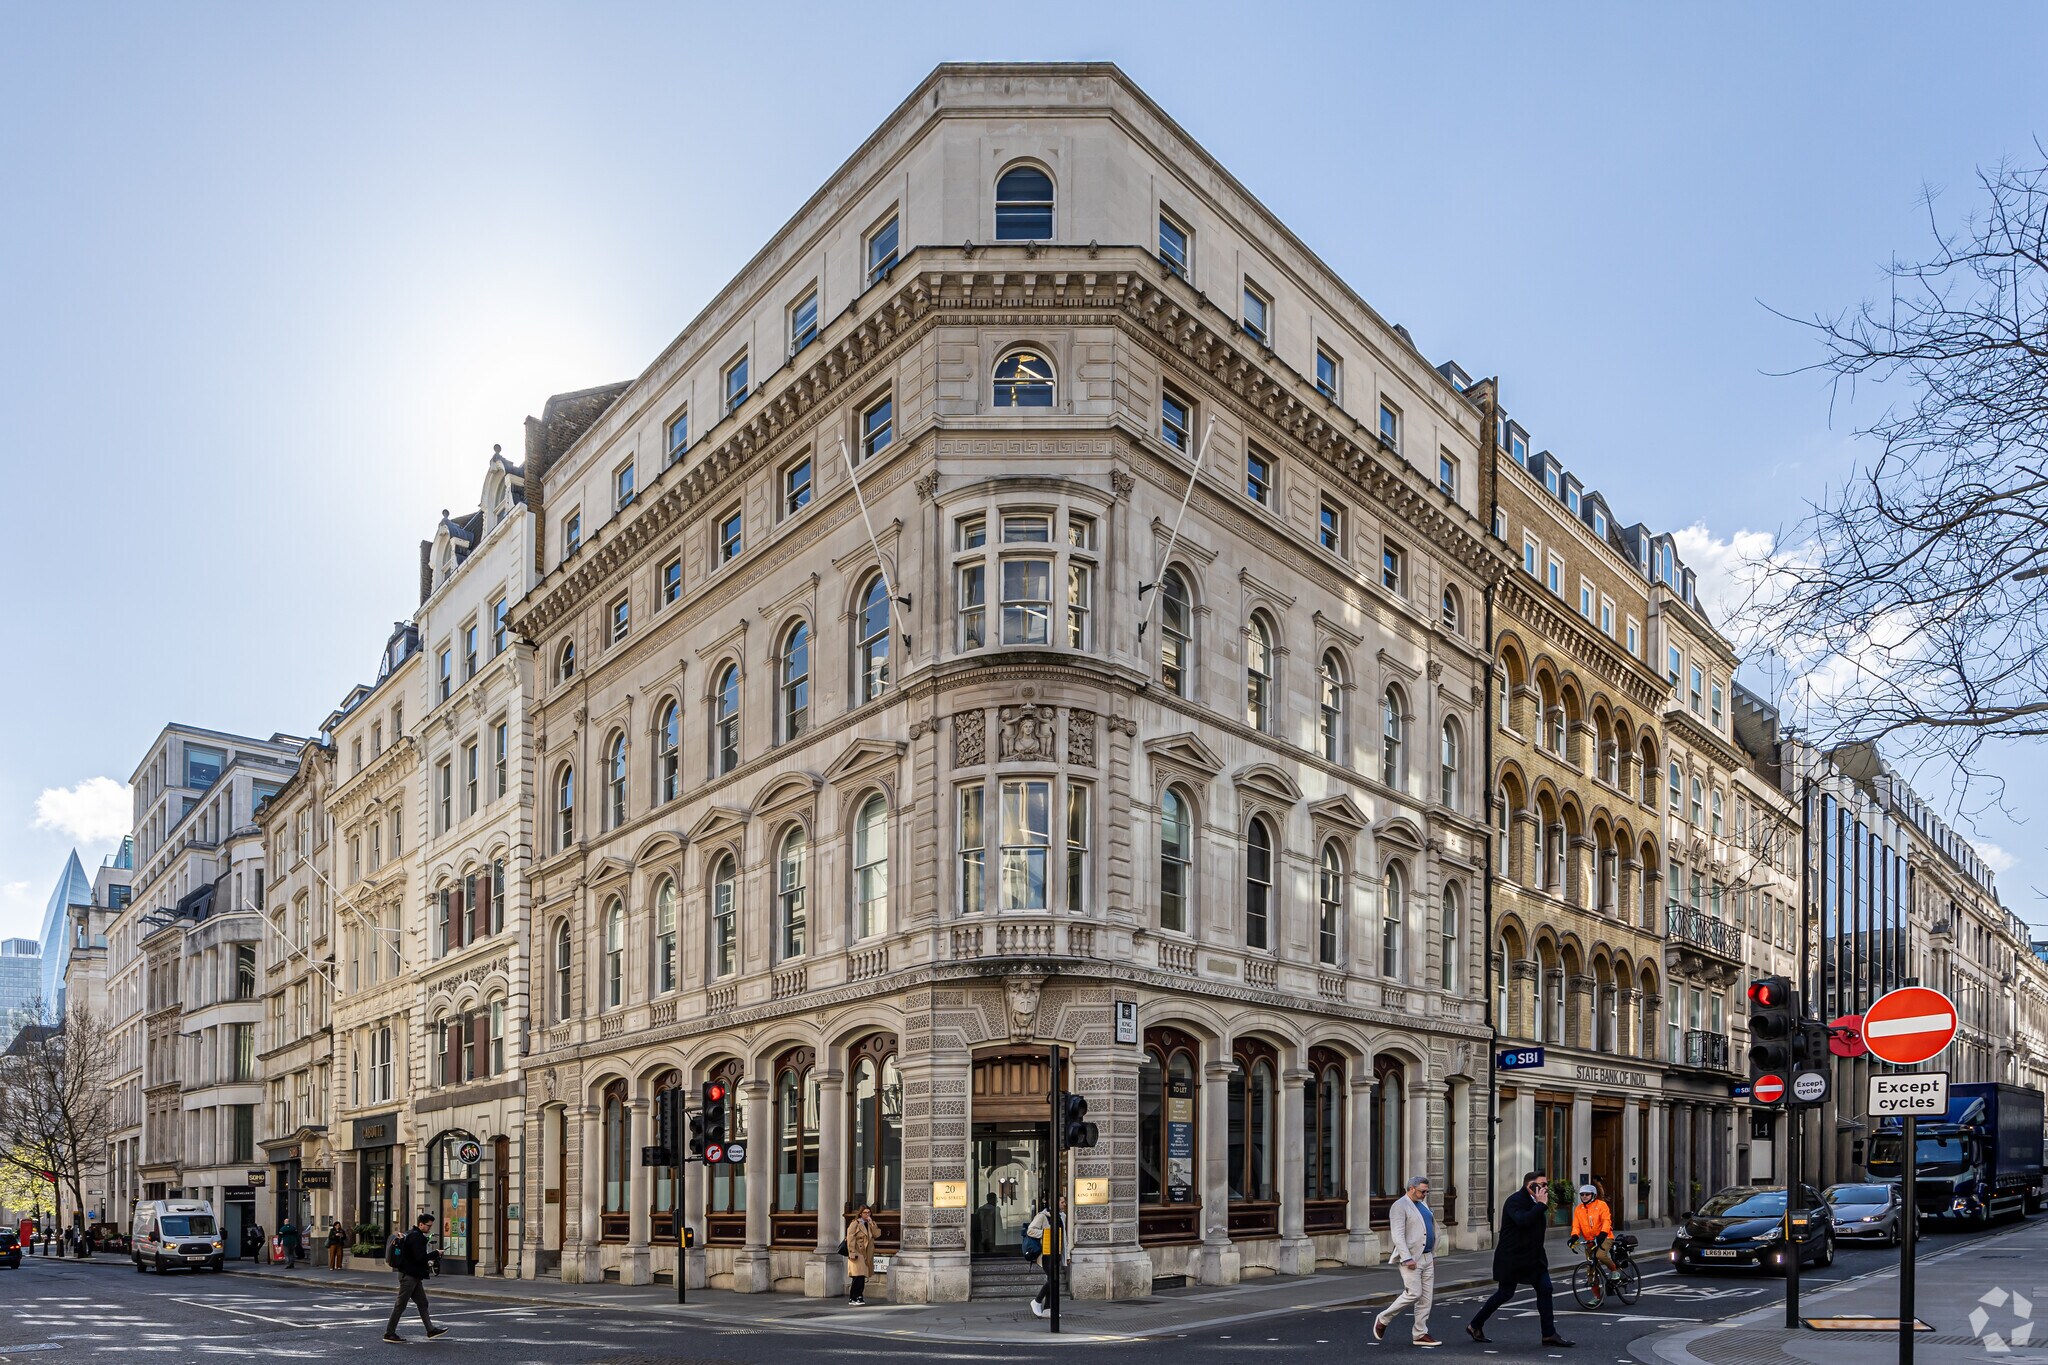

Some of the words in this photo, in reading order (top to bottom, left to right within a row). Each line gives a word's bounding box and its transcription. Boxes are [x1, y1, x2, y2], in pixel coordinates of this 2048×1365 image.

[1518, 1052, 1538, 1064] SBI
[1576, 1065, 1598, 1081] STATE
[1600, 1068, 1618, 1084] BANK
[1620, 1071, 1628, 1084] OF
[1630, 1072, 1646, 1086] INDIA
[1796, 1080, 1824, 1090] Except
[1877, 1080, 1940, 1095] Except
[1797, 1087, 1822, 1096] cycles
[1879, 1096, 1935, 1111] cycles
[1754, 1122, 1768, 1136] 14
[945, 1185, 956, 1194] 20
[1086, 1182, 1097, 1191] 20
